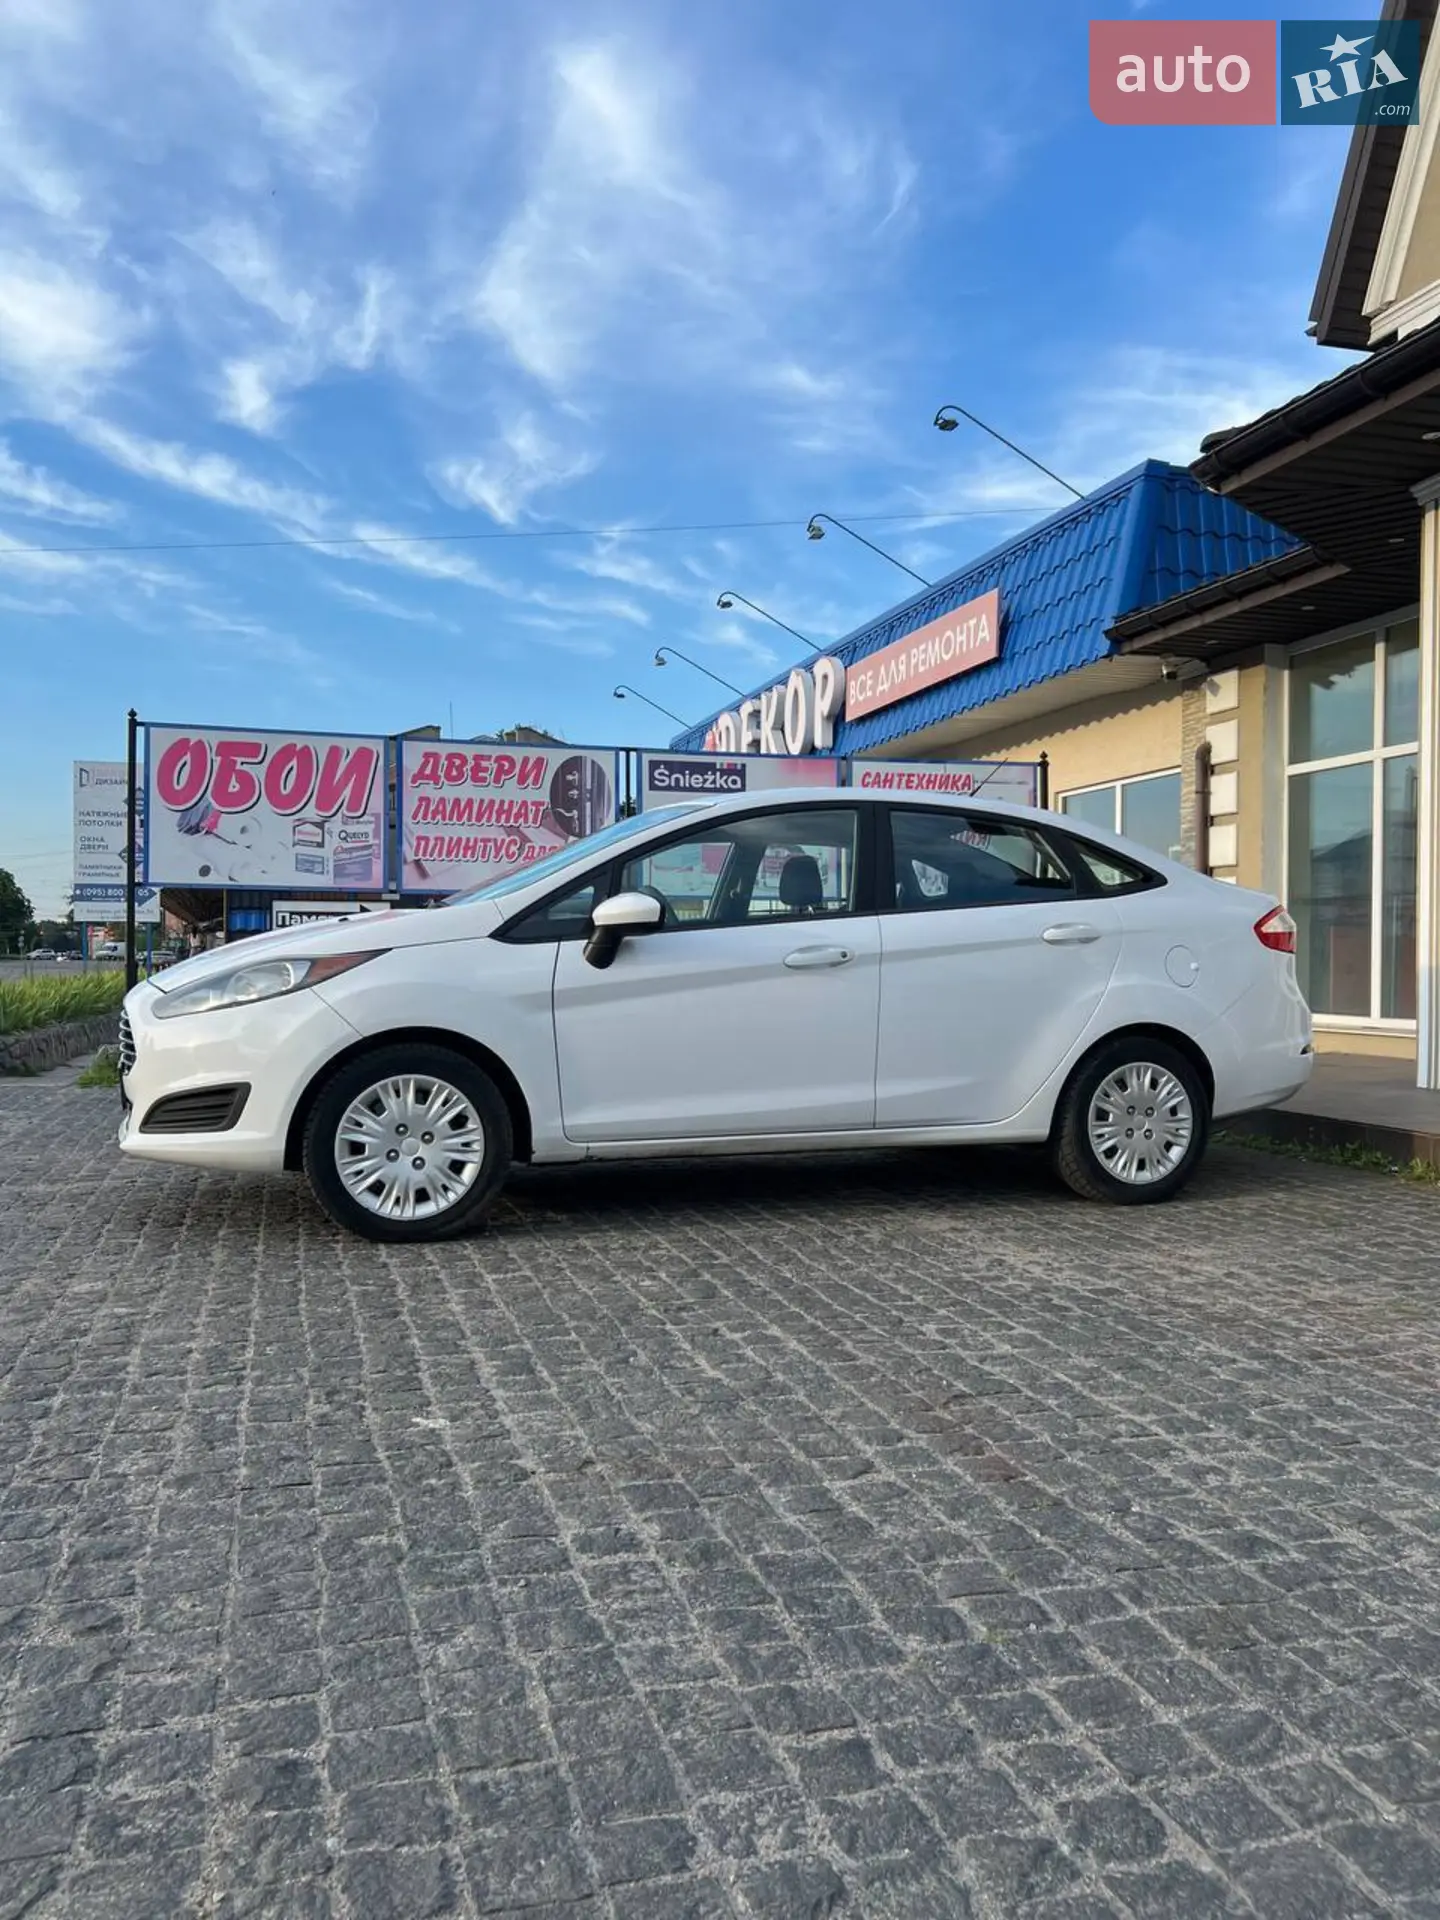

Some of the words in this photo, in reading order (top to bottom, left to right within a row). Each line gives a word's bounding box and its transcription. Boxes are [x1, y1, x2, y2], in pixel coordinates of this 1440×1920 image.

[849, 670, 874, 706] ВСЕ
[876, 653, 907, 697] ДЛЯ
[910, 613, 990, 678] РЕМОНТА
[156, 737, 379, 817] ОБОИ
[411, 751, 548, 788] ДВЕРИ
[653, 764, 742, 789] Śnieżka
[861, 771, 973, 792] САНТЕХНИКА
[411, 796, 548, 827] ЛАМИНАТ
[414, 835, 520, 863] ПЛИНТУС
